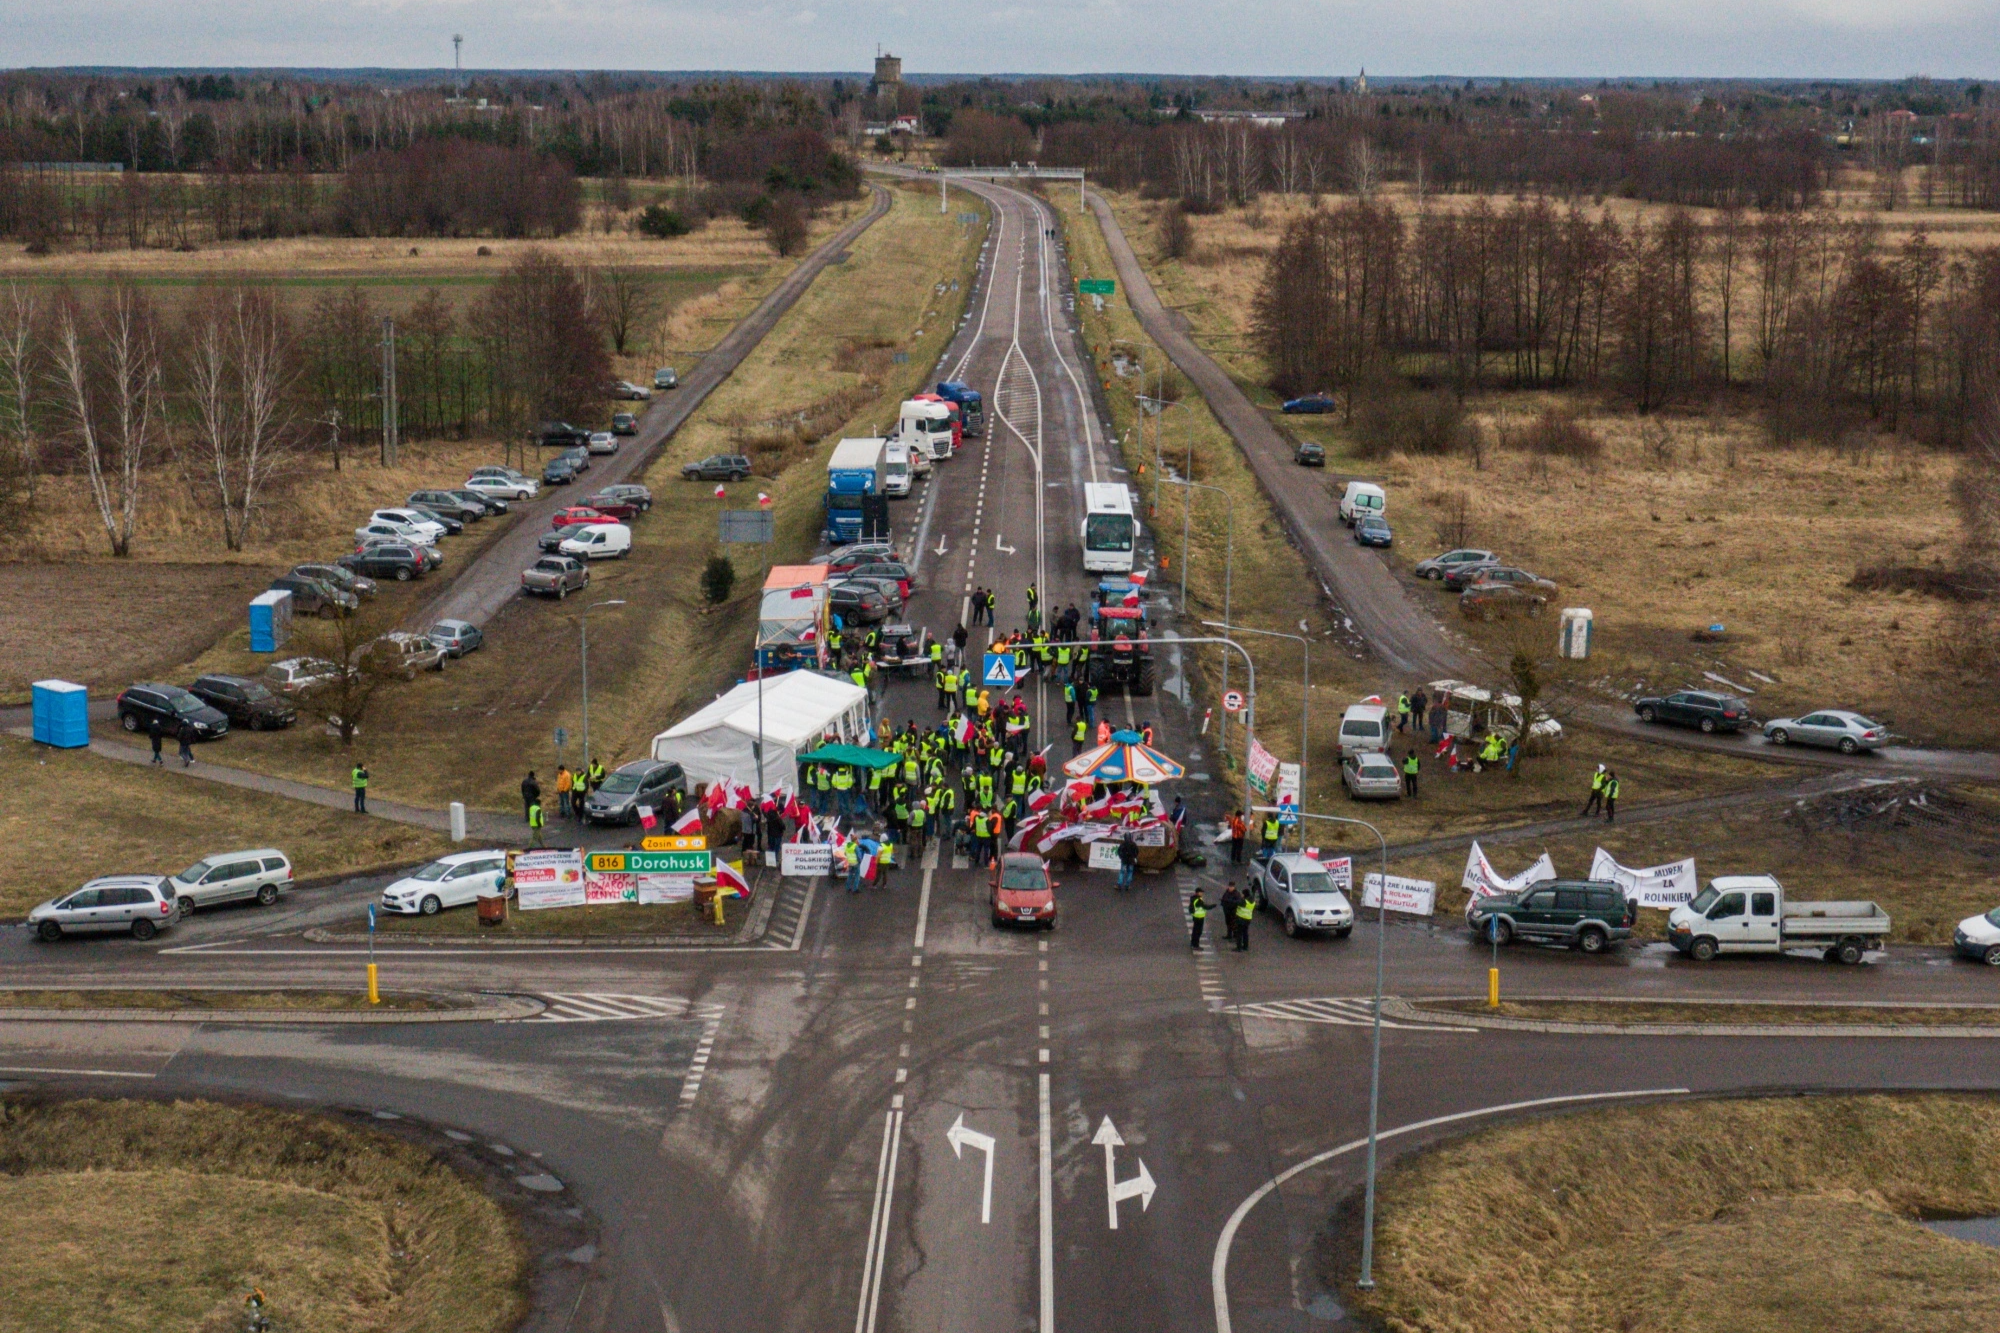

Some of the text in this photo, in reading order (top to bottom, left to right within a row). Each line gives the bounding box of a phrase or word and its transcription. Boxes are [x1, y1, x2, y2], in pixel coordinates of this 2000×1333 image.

[647, 840, 672, 848] Zosin
[598, 856, 705, 869] 816 Dorohusk
[1654, 865, 1684, 877] MUREM
[598, 873, 631, 881] STOP
[586, 881, 635, 890] TOWAROM
[1663, 880, 1675, 888] ZA
[1405, 885, 1430, 893] BALUJE
[622, 890, 636, 899] UA
[1389, 890, 1413, 899] ROLNIK
[1644, 892, 1693, 903] ROLNIKIEM
